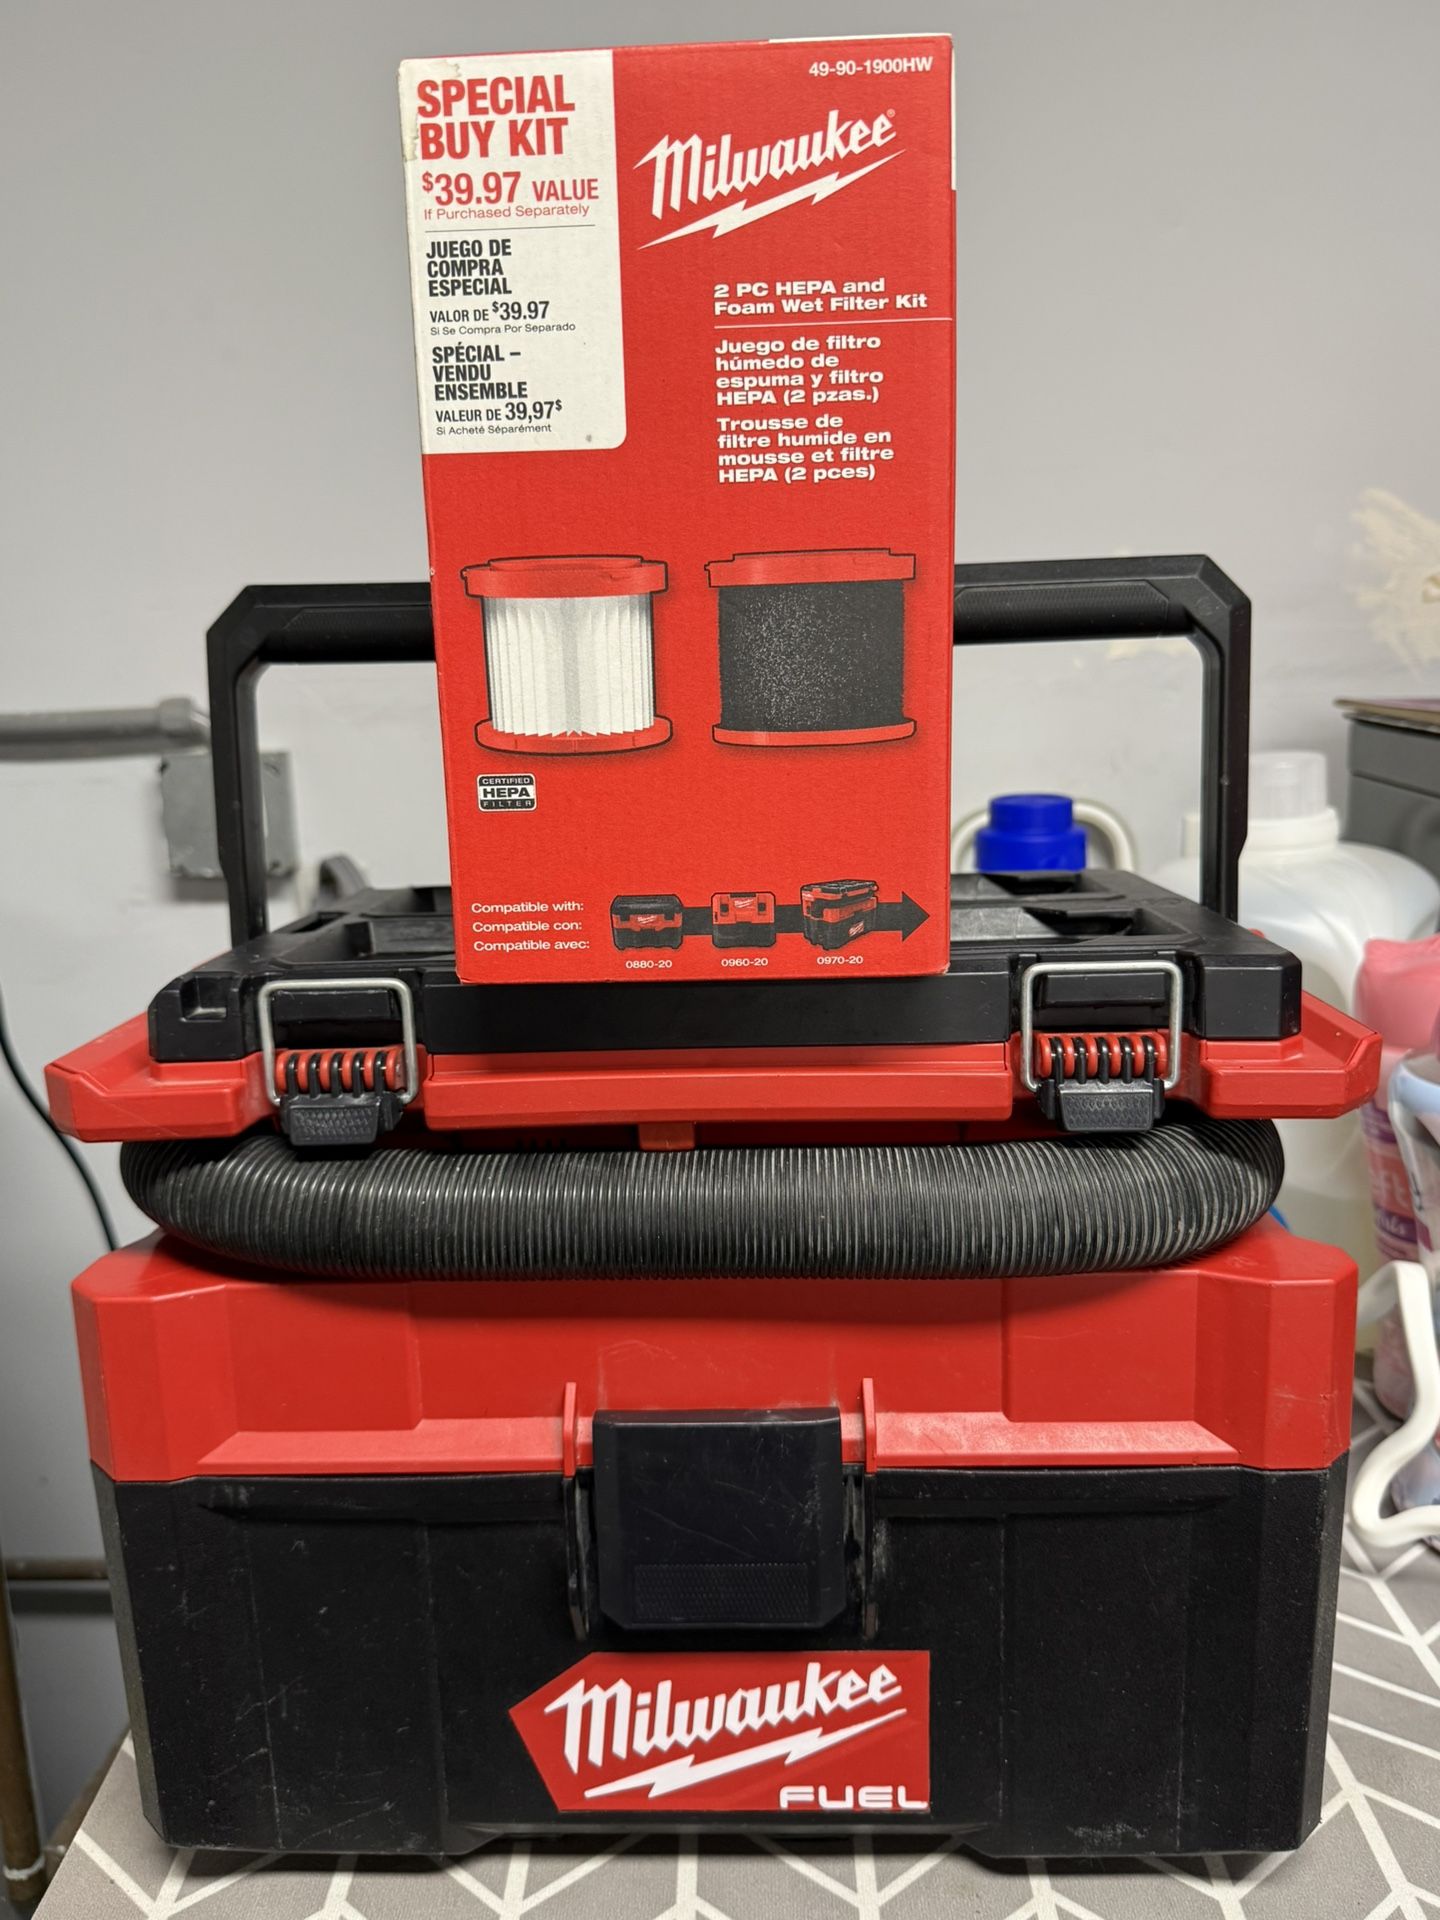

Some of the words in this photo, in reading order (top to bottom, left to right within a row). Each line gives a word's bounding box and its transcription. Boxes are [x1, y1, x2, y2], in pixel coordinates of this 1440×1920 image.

[808, 56, 933, 77] 49-90-1900HW
[417, 74, 575, 118] SPECIAL
[420, 120, 495, 160] BUY
[509, 117, 569, 157] KIT
[633, 109, 897, 220] Milwaukee
[422, 171, 521, 206] $39.97
[532, 178, 599, 202] VALUE
[424, 208, 434, 220] If
[436, 205, 512, 220] Purchased
[515, 203, 590, 219] Separately
[426, 239, 483, 259] JUEGO
[489, 238, 512, 257] DE
[427, 258, 504, 278] COMPRA
[428, 277, 512, 297] ESPECIAL
[714, 283, 730, 298] 2
[736, 281, 769, 298] PC
[775, 280, 837, 296] HEPA
[843, 277, 885, 294] and
[430, 309, 470, 323] VALOR
[473, 308, 489, 322] DE
[492, 300, 550, 321] $39.97
[714, 299, 775, 316] Foam
[782, 297, 824, 314] Wet
[830, 295, 890, 312] Filter
[896, 293, 928, 309] Kit
[430, 327, 440, 336] Si
[442, 326, 456, 336] Se
[459, 325, 501, 337] Compra
[504, 324, 521, 334] Por
[525, 322, 576, 334] Separado
[432, 342, 505, 364] SPÉCIAL
[715, 339, 785, 356] Juego
[791, 336, 820, 351] de
[826, 334, 881, 350] filtro
[715, 354, 805, 371] húmedo
[810, 353, 839, 369] de
[433, 364, 491, 382] VENDU
[715, 372, 805, 391] espuma
[810, 373, 823, 389] y
[829, 369, 884, 385] filtro
[434, 381, 528, 402] ENSEMBLE
[716, 391, 777, 406] HEPA
[783, 389, 806, 407] (2
[812, 386, 879, 406] pzas.)
[436, 409, 482, 423] VALEUR
[486, 408, 501, 421] DE
[505, 399, 562, 423] 39,97$
[436, 427, 446, 436] Si
[448, 425, 485, 436] Acheté
[488, 423, 552, 436] Séparément
[716, 416, 809, 432] Trousse
[815, 413, 843, 429] de
[717, 432, 771, 449] filtre
[777, 430, 857, 447] humide
[863, 430, 892, 444] en
[718, 450, 805, 467] mousse
[811, 448, 835, 463] et
[840, 446, 894, 462] filtre
[718, 467, 778, 484] HEPA
[784, 466, 807, 485] (2
[813, 464, 876, 484] pces)
[482, 776, 531, 786] CERTIFIED
[483, 786, 531, 799] HEPA
[483, 799, 532, 808] FILTER
[471, 901, 549, 915] Compatible
[552, 899, 584, 912] with:
[472, 919, 550, 934] Compatible
[553, 920, 582, 932] con:
[473, 938, 551, 953] Compatible
[554, 939, 590, 951] avec:
[625, 959, 673, 970] 0880-20
[721, 957, 769, 968] 0960-20
[816, 955, 864, 965] 0970-20
[544, 1662, 902, 1775] Milwaukee
[779, 1785, 929, 1811] FUEL
